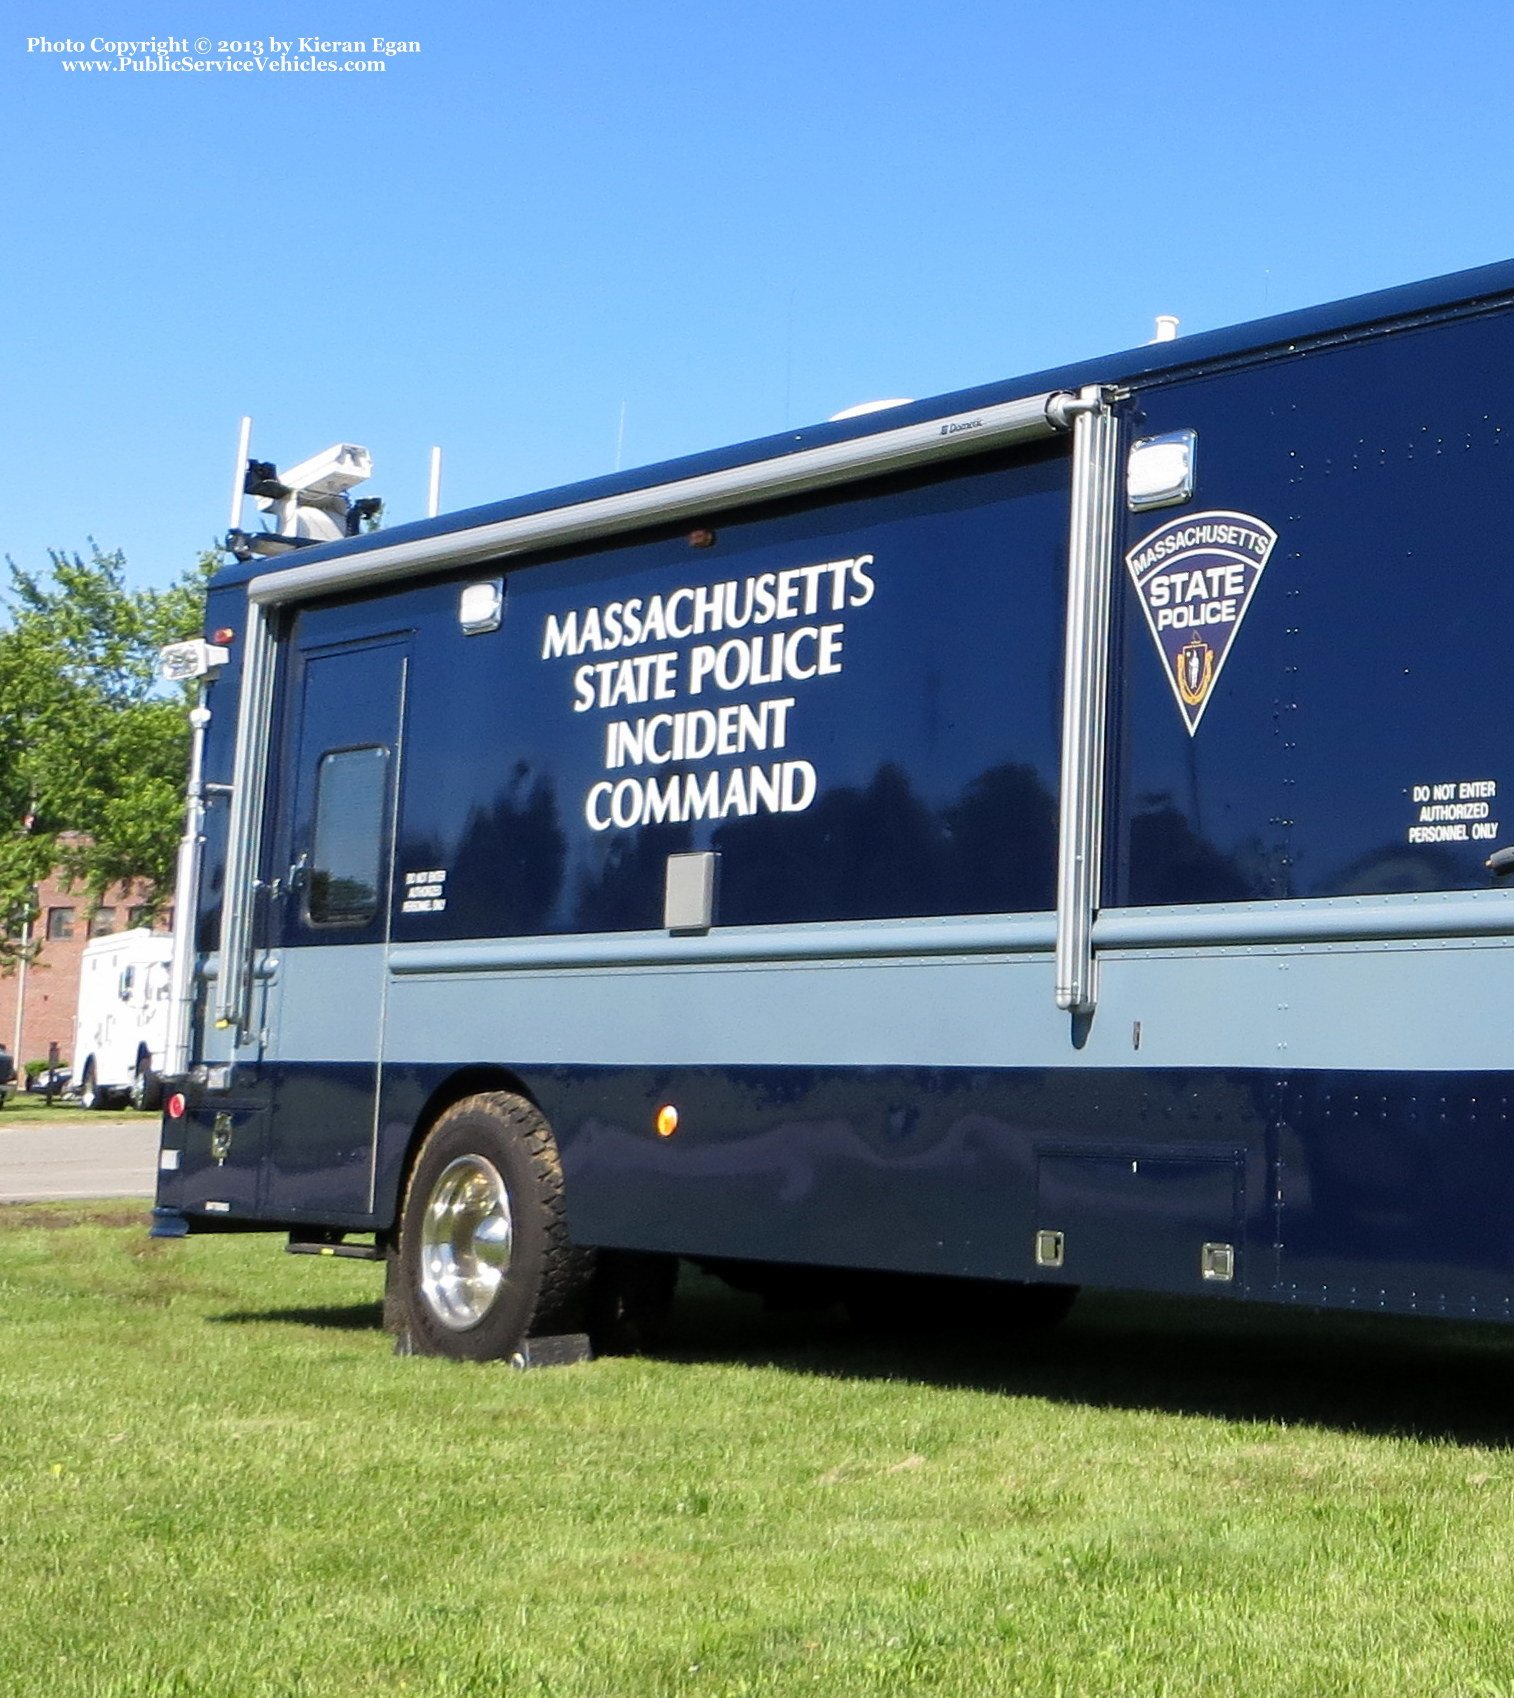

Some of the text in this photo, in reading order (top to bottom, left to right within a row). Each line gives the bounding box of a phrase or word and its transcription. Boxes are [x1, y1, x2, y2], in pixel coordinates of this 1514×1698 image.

[1132, 524, 1269, 575] MASSACHUSETTS
[541, 554, 875, 660] MASSACHUSETTS
[1150, 563, 1245, 607] STATE
[1158, 599, 1236, 631] POLICE
[573, 623, 844, 712] STATE POLICE
[606, 698, 795, 769] INCIDENT
[585, 760, 817, 831] COMMAND
[1413, 781, 1496, 802] DO NOT ENTER
[1419, 802, 1489, 822] AUTHORIZED
[1408, 822, 1499, 843] PERSONNEL ONLY
